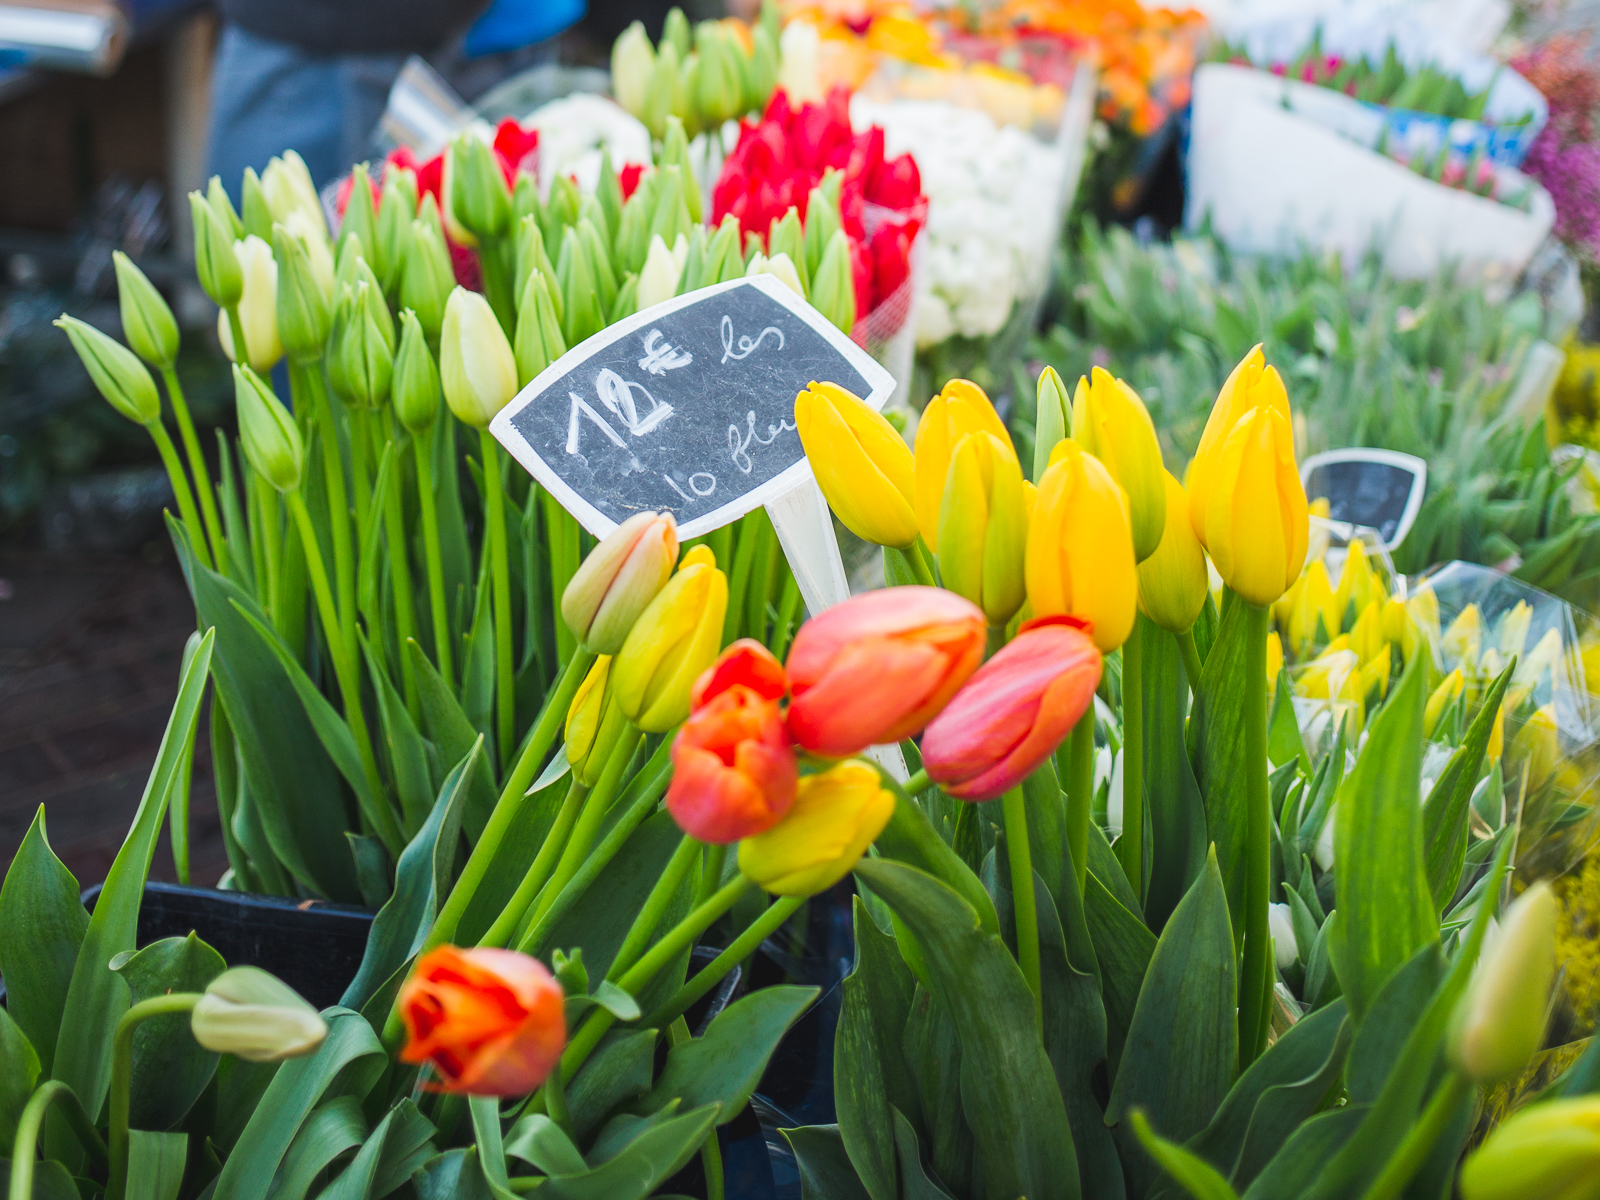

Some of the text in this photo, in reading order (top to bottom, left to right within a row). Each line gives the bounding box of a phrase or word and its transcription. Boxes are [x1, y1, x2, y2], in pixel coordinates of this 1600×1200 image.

[720, 314, 785, 365] les
[663, 409, 798, 502] 10 fleu
